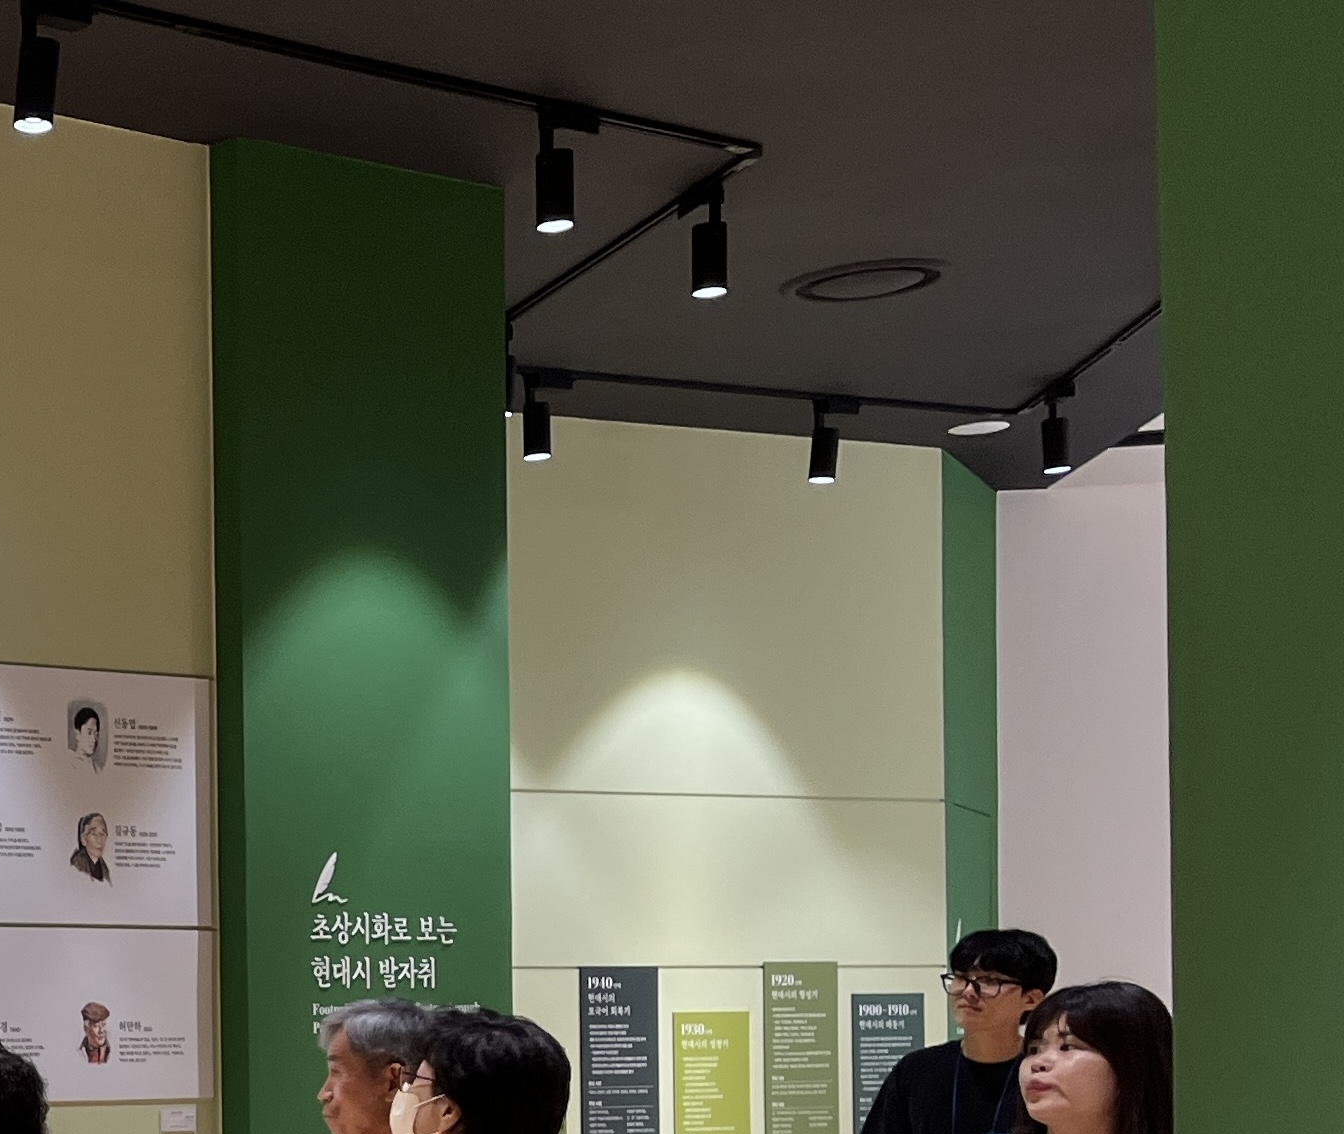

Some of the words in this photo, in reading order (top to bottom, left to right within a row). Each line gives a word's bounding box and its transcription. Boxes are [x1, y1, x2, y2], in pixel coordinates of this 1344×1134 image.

[310, 911, 412, 945] 초상시화로
[416, 916, 458, 944] 보는
[311, 956, 371, 989] 현대시
[379, 956, 436, 989] 발자취
